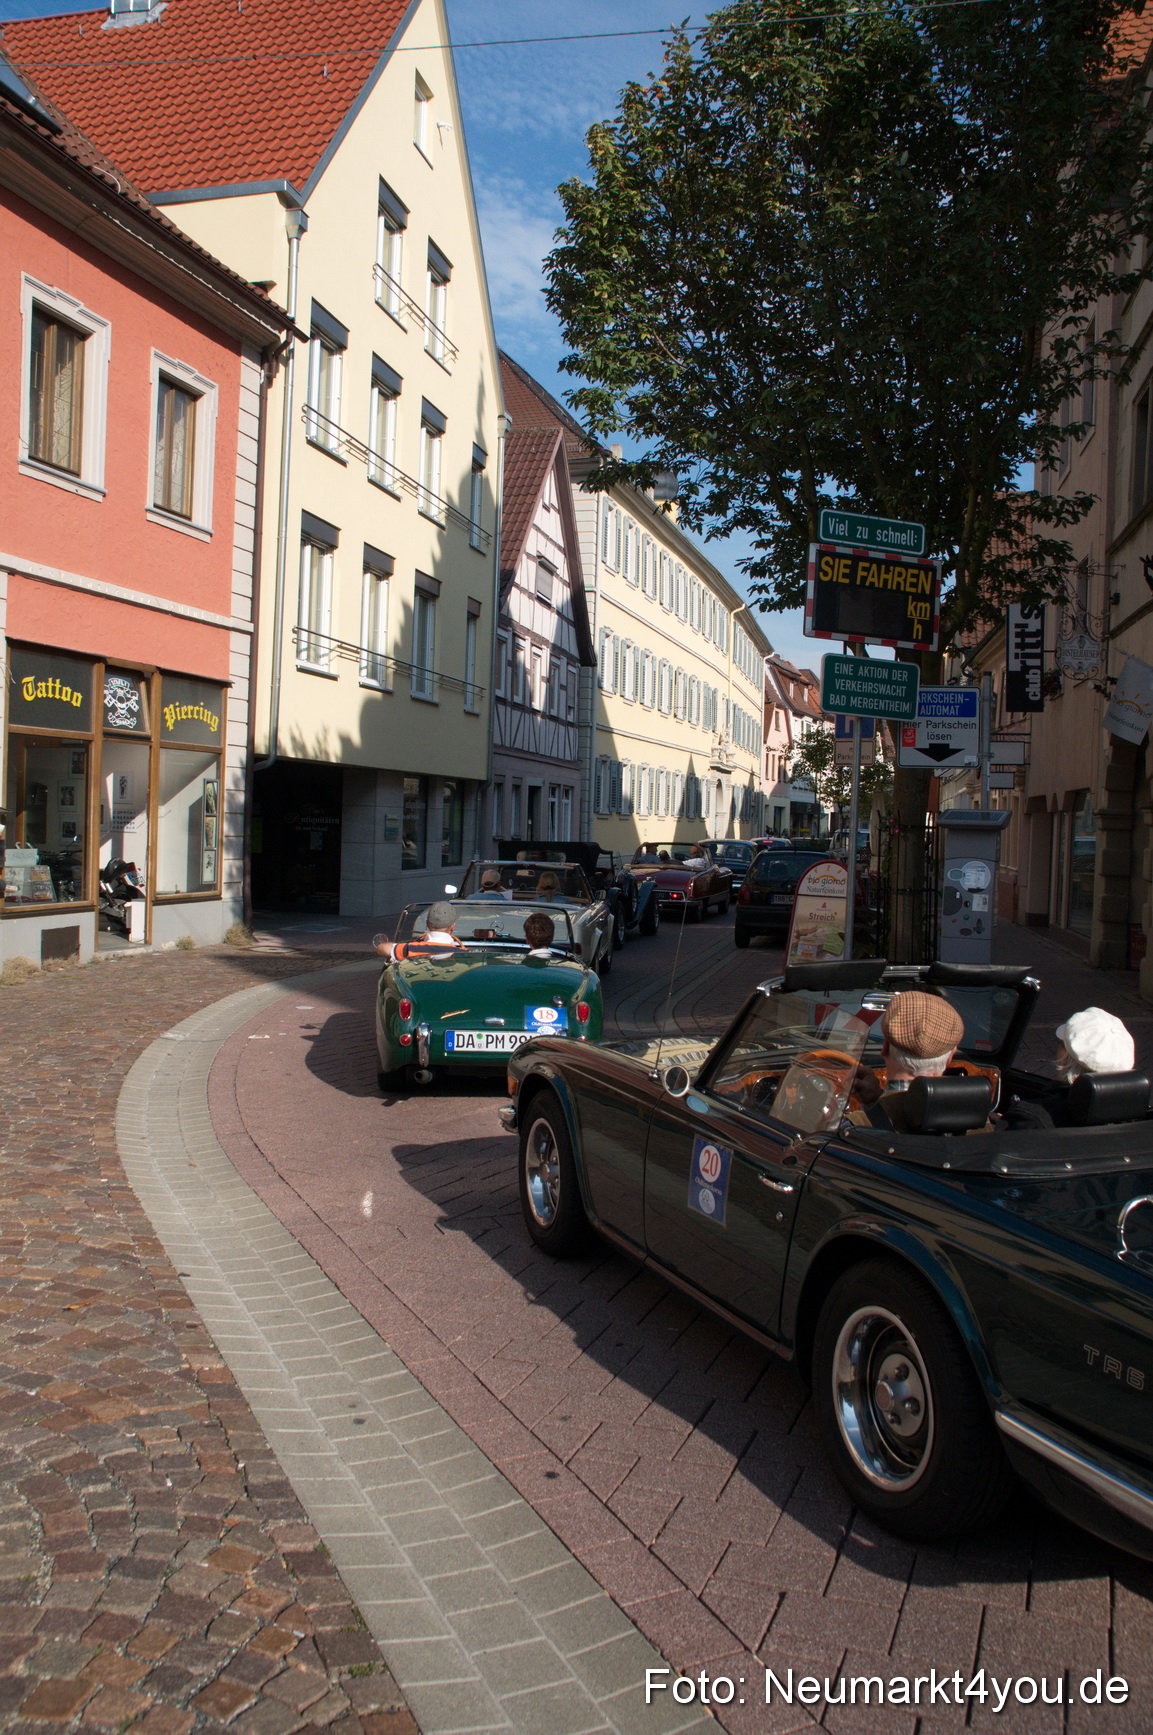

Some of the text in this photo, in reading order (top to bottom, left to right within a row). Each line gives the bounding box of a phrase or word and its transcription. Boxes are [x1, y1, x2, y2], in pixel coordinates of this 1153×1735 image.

[828, 517, 918, 546] Viel zu schnell:
[819, 555, 933, 595] SIE FAHREN
[907, 595, 931, 619] km
[912, 619, 923, 640] h
[834, 662, 909, 682] EINE AKTION DER
[834, 678, 907, 698] VERKEHRSWACHT
[21, 675, 219, 732] Tattoo Piercing
[829, 693, 847, 706] BAD
[920, 705, 960, 716] AUTOMAT
[903, 719, 977, 730] Hier Parkschein
[927, 731, 952, 741] lösen
[806, 886, 845, 895] Naturfeinkost
[808, 912, 835, 922] Streich
[536, 1009, 555, 1020] 18
[455, 1033, 475, 1049] DA
[485, 1034, 505, 1049] PM
[509, 1034, 533, 1049] 99
[701, 1149, 719, 1177] 20
[1083, 1343, 1145, 1391] TR6
